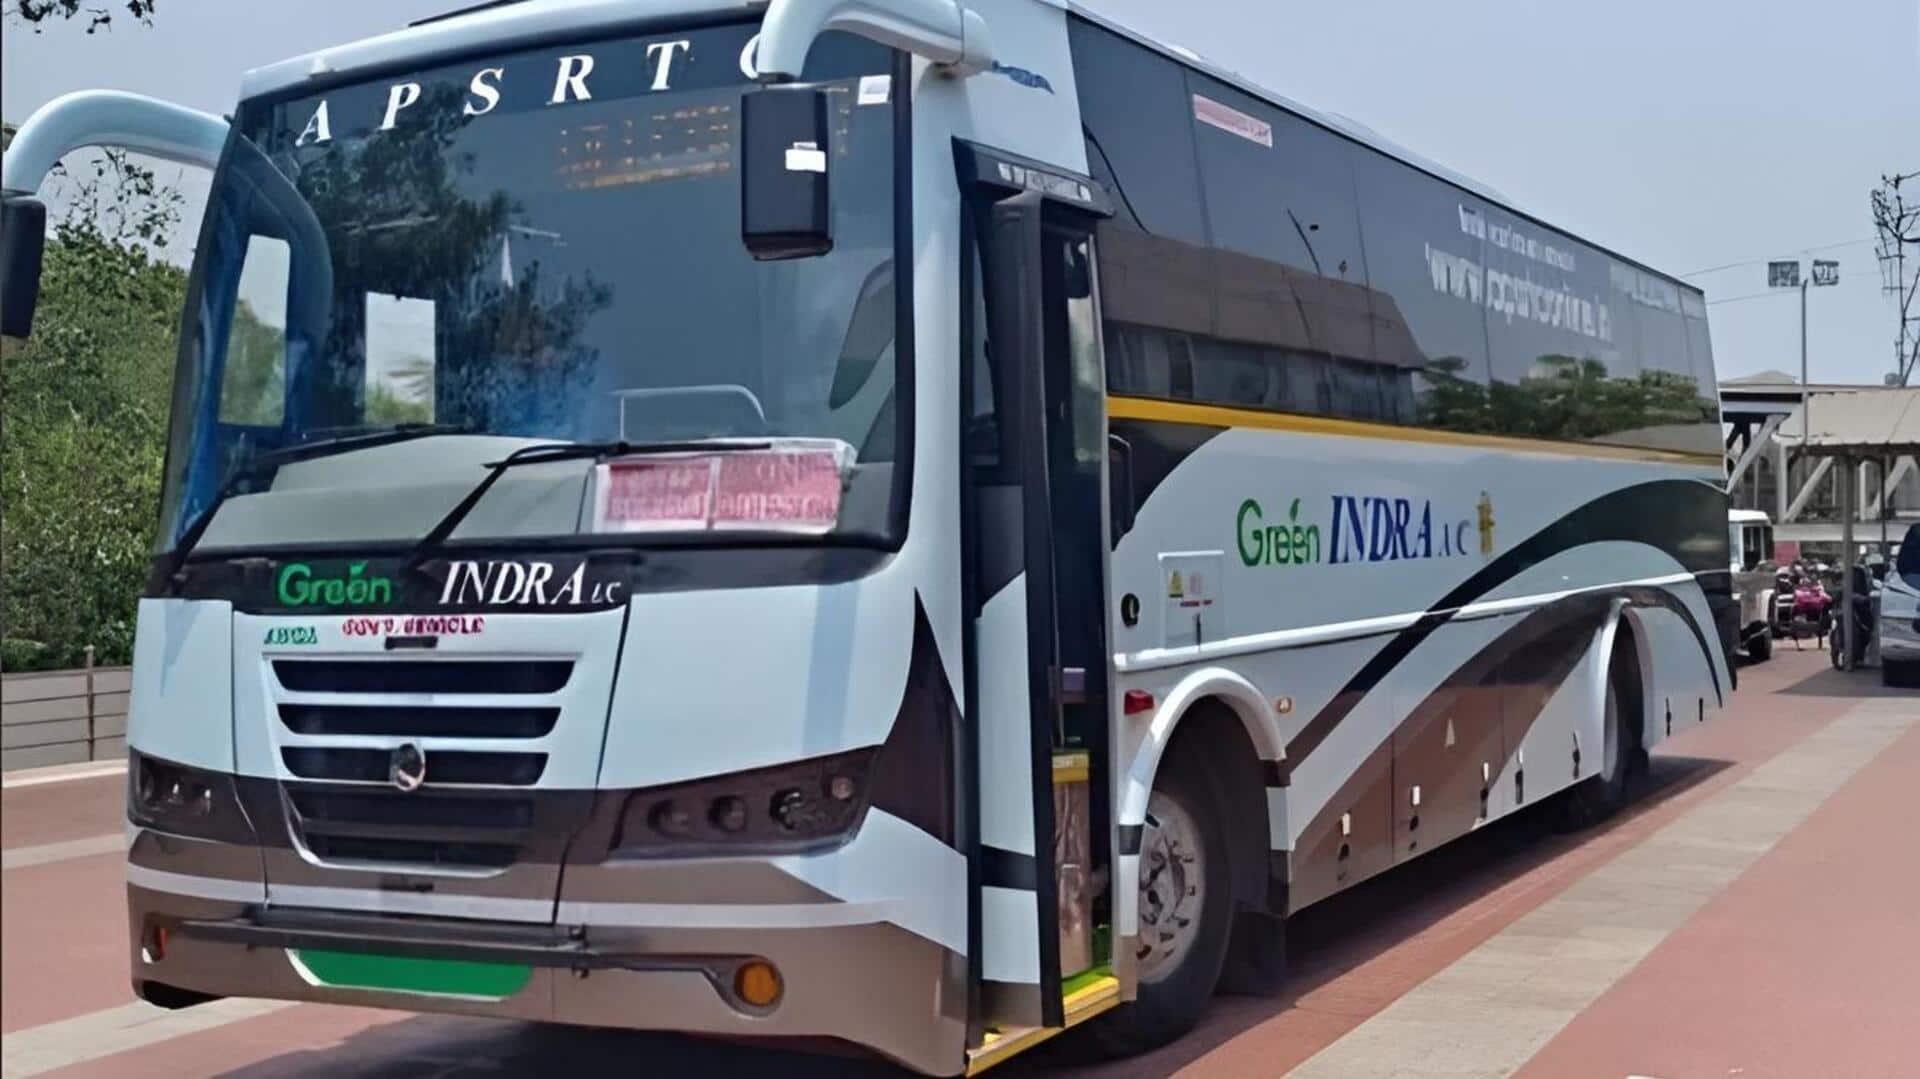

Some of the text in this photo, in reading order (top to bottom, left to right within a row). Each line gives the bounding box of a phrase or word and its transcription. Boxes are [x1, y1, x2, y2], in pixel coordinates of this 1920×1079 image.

[1237, 498, 1320, 567] Green
[1329, 496, 1432, 564] INDRA
[277, 561, 391, 606] Green
[439, 560, 587, 604] INDRA
